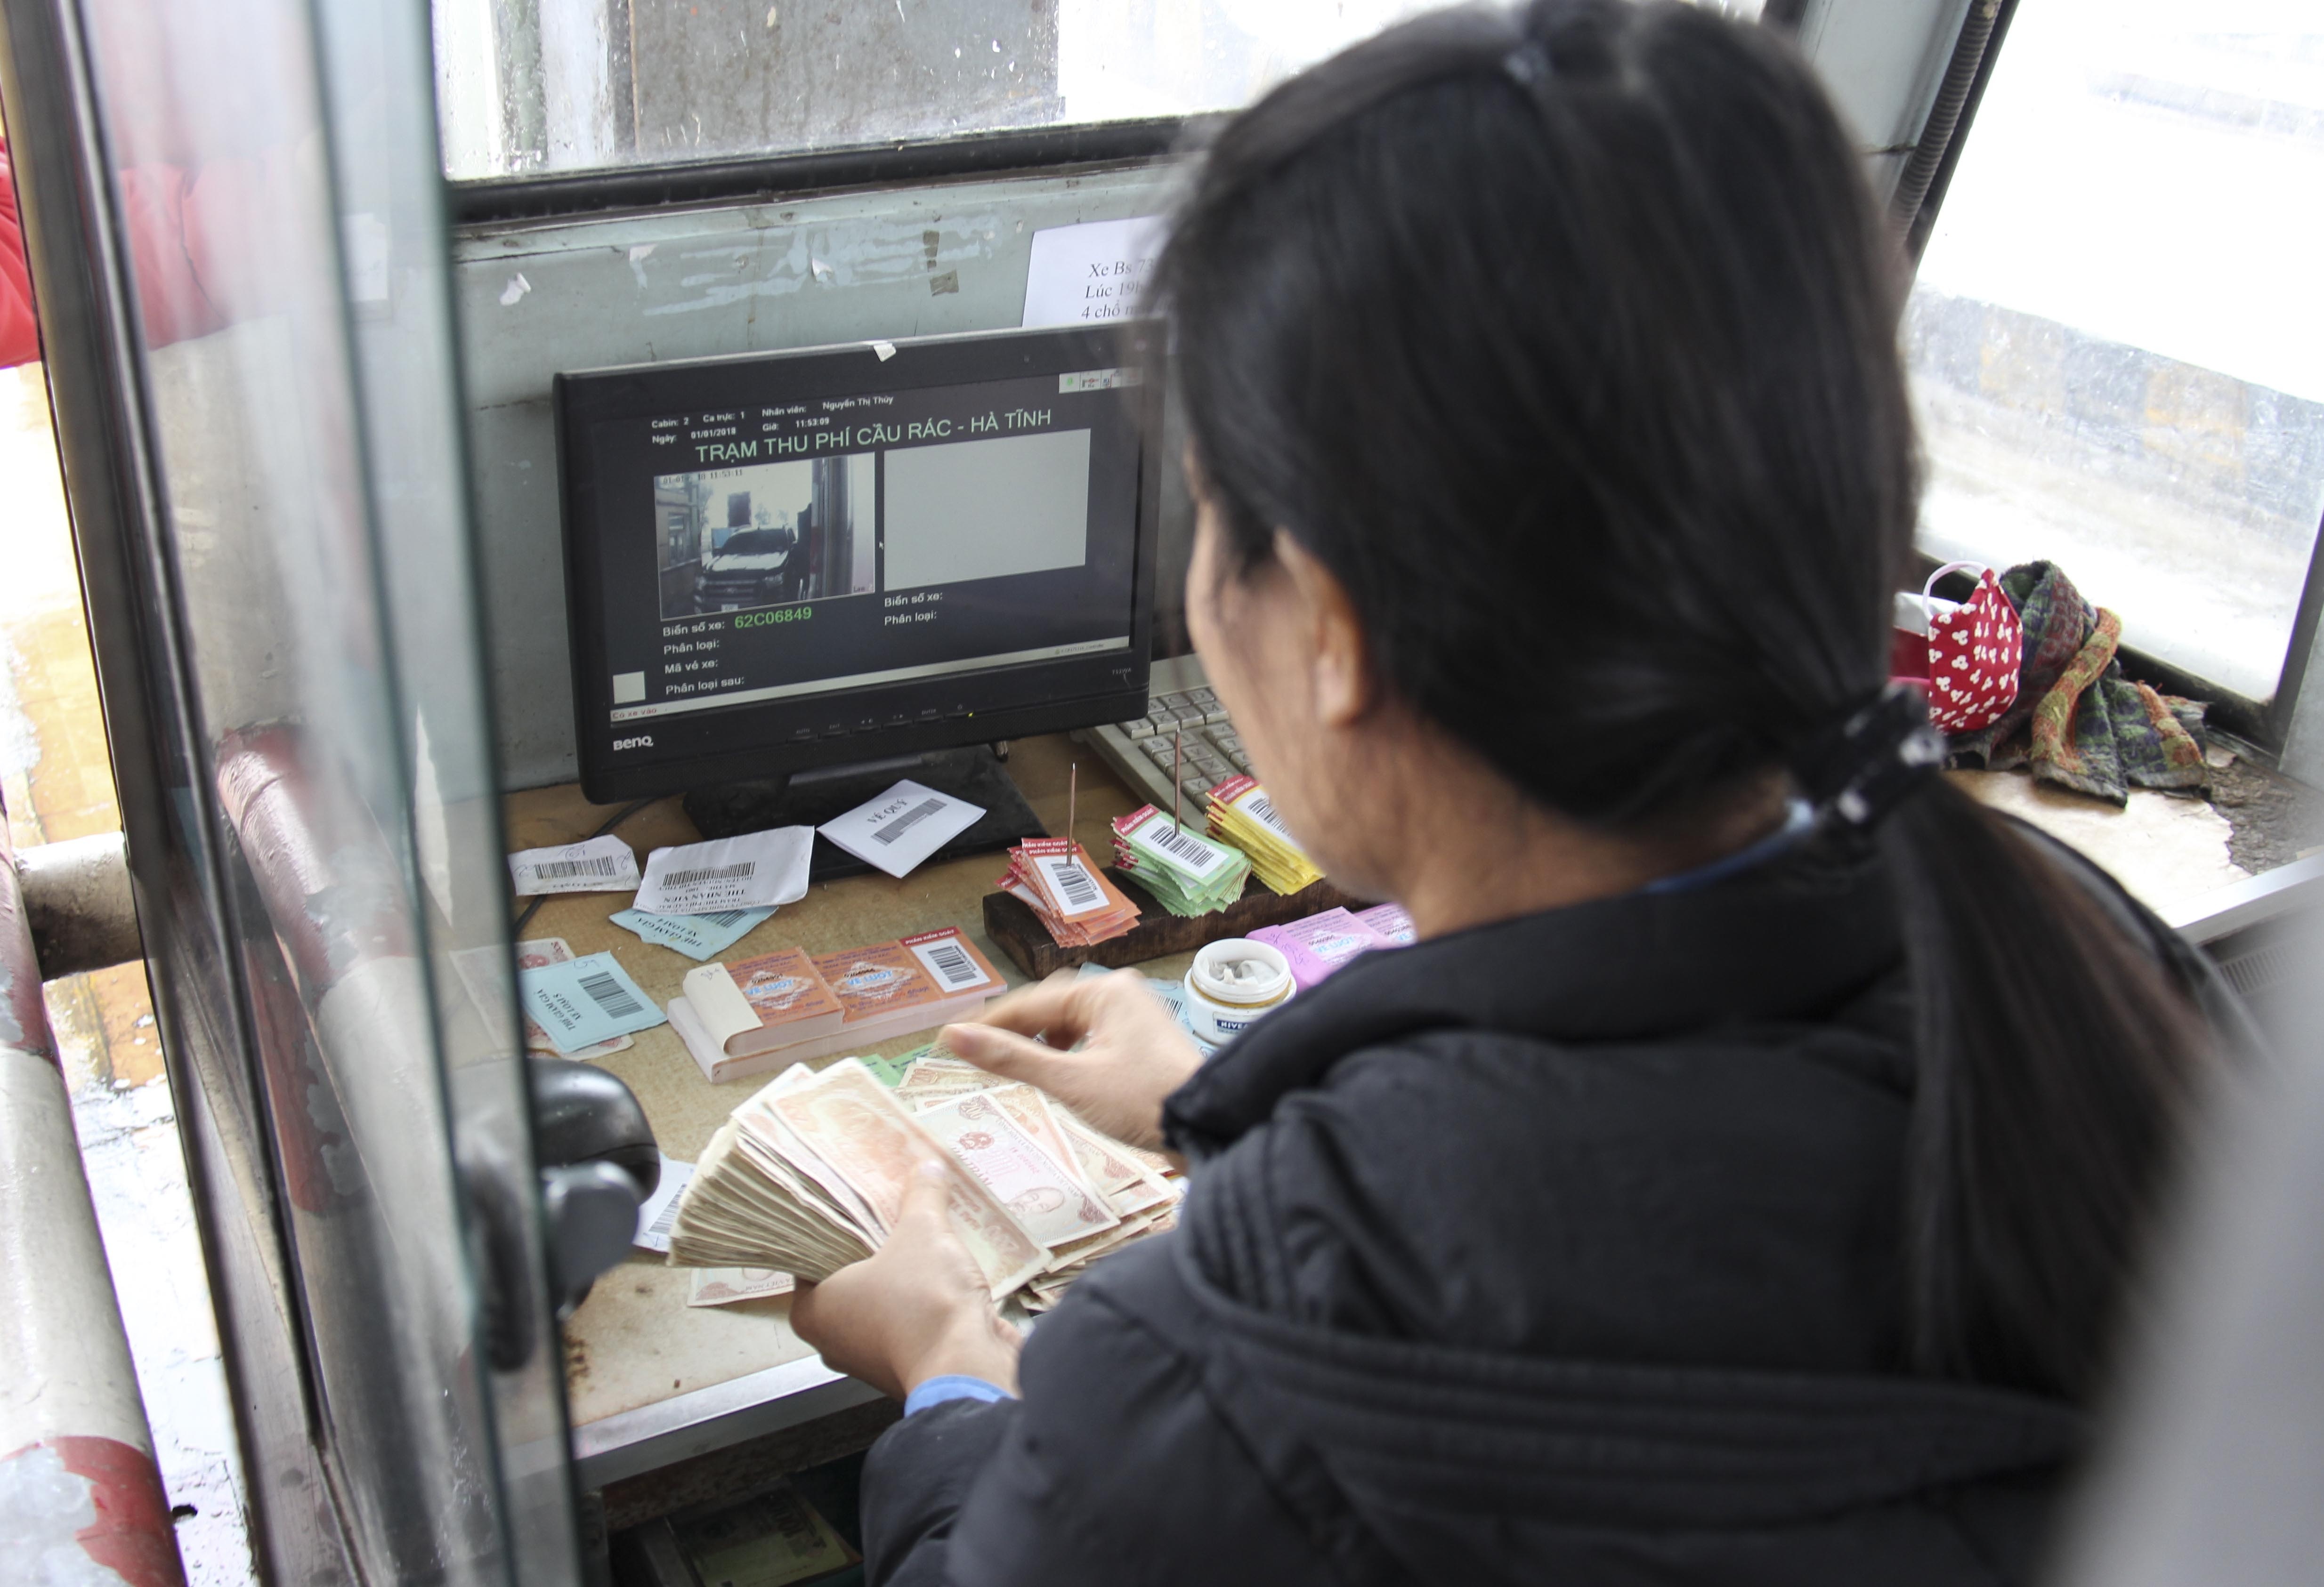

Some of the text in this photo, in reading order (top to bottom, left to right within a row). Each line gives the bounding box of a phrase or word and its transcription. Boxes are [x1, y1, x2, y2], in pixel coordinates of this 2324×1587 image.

[1089, 263, 1109, 278] Xe
[1114, 261, 1132, 275] Bs
[1085, 283, 1112, 299] Lúc
[1081, 306, 1090, 320] 4
[651, 418, 679, 429] Cabin:
[683, 417, 689, 426] 2
[703, 414, 715, 423] Ca
[740, 411, 745, 419] 1
[762, 407, 785, 417] Nhân
[786, 404, 807, 415] viên:
[822, 398, 855, 411] Nguyễn
[857, 397, 871, 407] Thị
[652, 434, 677, 445] Ngày:
[690, 427, 737, 439] 01/01/2018
[795, 417, 830, 428] 11:53:09
[695, 440, 757, 463] TRẠM
[763, 433, 808, 455] THU
[815, 426, 850, 450] PHÍ
[908, 417, 952, 441] RÁC
[971, 411, 999, 433] HÀ
[1004, 409, 1052, 429] TĨNH
[926, 592, 943, 602] xe:
[708, 620, 725, 631] xe:
[734, 606, 812, 628] 62C06849
[884, 611, 938, 626] Phân loại:
[664, 638, 720, 655] Phân loại:
[664, 662, 682, 674] Mã
[701, 658, 719, 669] xe:
[665, 675, 745, 696] Phân loại sau:
